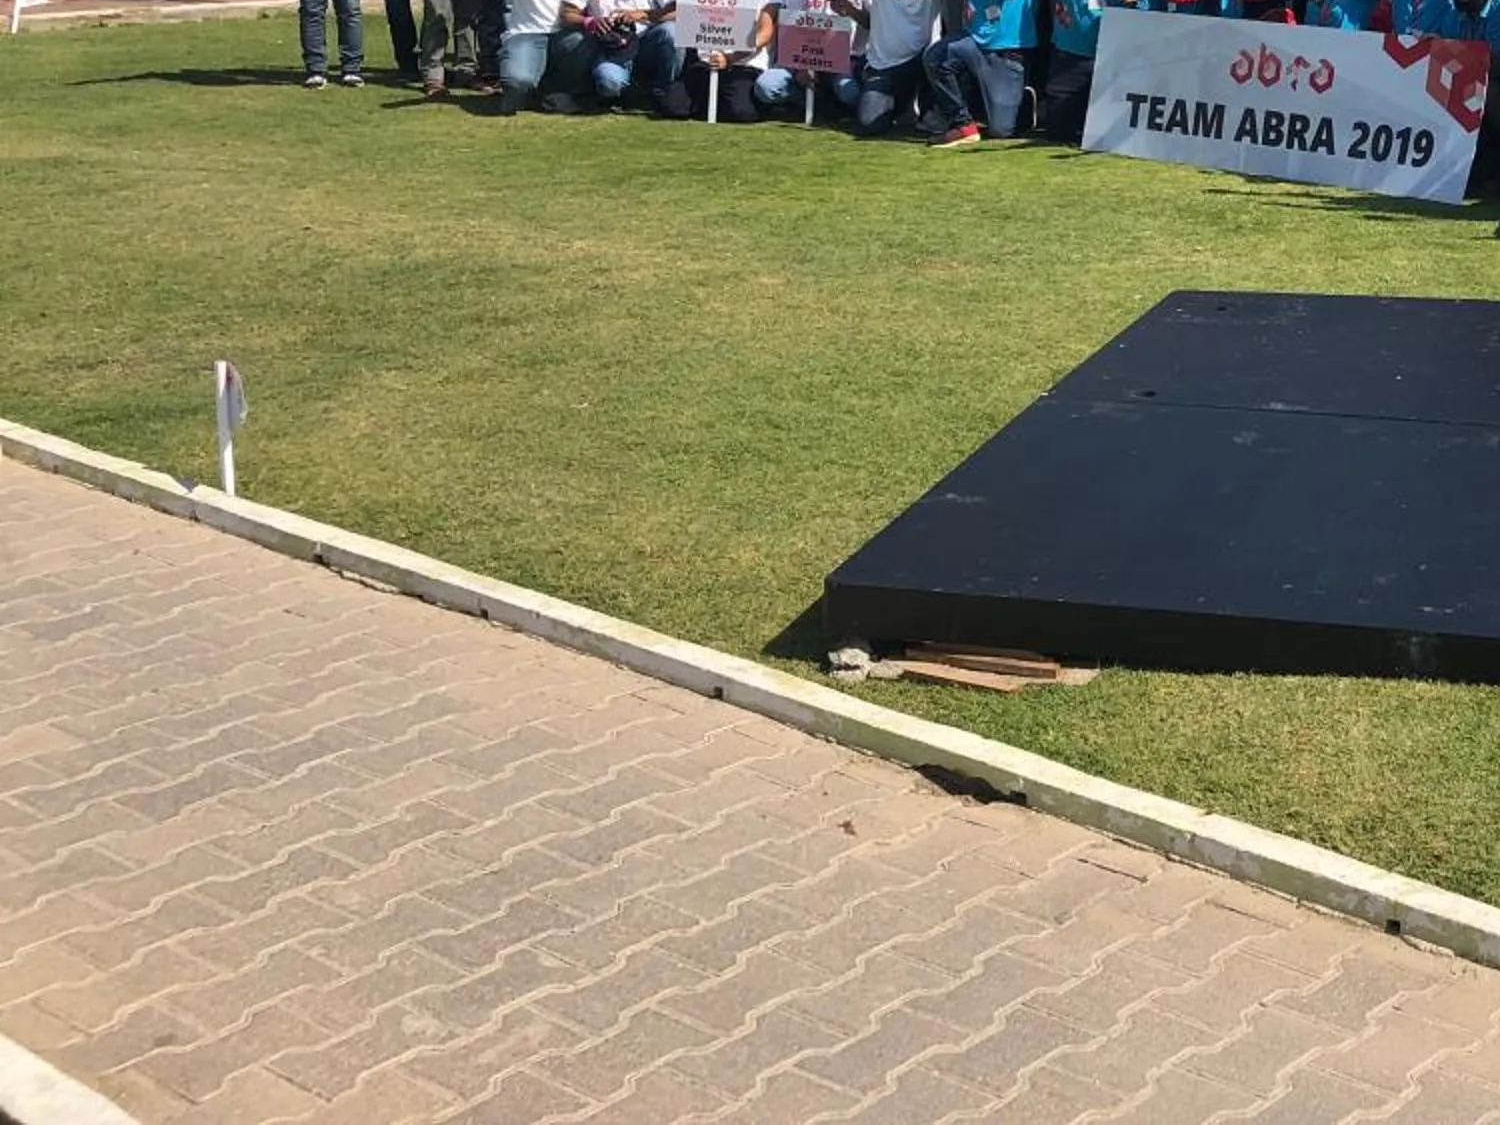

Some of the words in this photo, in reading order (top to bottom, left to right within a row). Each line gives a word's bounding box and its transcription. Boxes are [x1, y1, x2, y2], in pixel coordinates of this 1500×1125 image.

[695, 34, 735, 46] Pirates
[700, 23, 733, 35] Silver
[1230, 42, 1335, 94] abra
[1125, 92, 1226, 140] TEAM
[1233, 107, 1335, 156] ABRA
[1347, 120, 1435, 168] 2019
